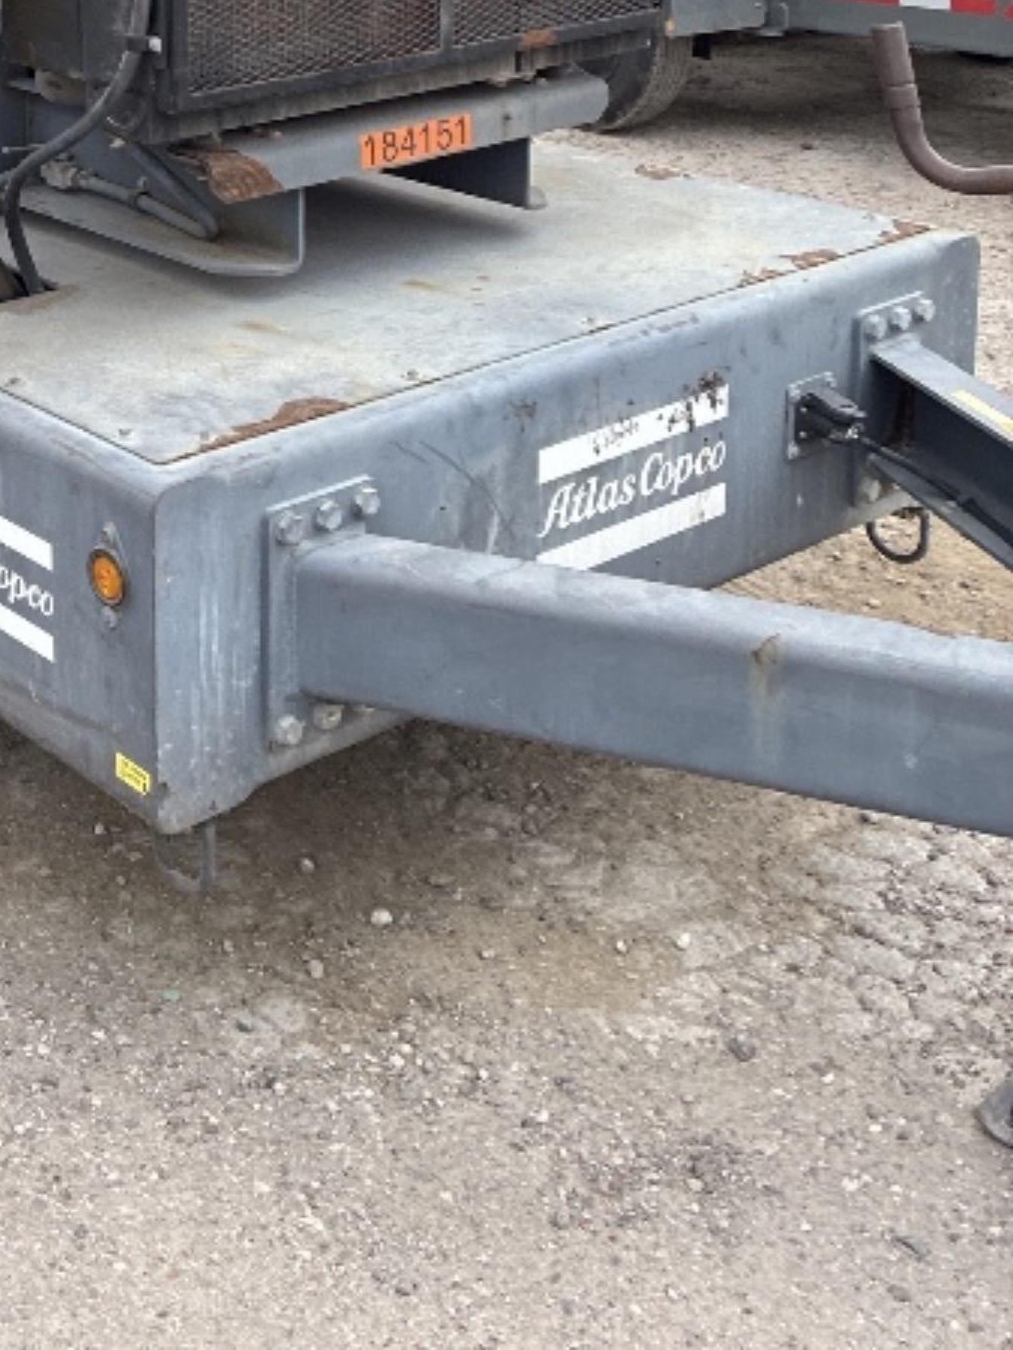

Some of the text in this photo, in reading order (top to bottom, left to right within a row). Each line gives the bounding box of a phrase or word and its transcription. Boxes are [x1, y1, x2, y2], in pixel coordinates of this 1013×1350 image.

[364, 116, 466, 166] 184151
[537, 441, 726, 538] Atlas Copco
